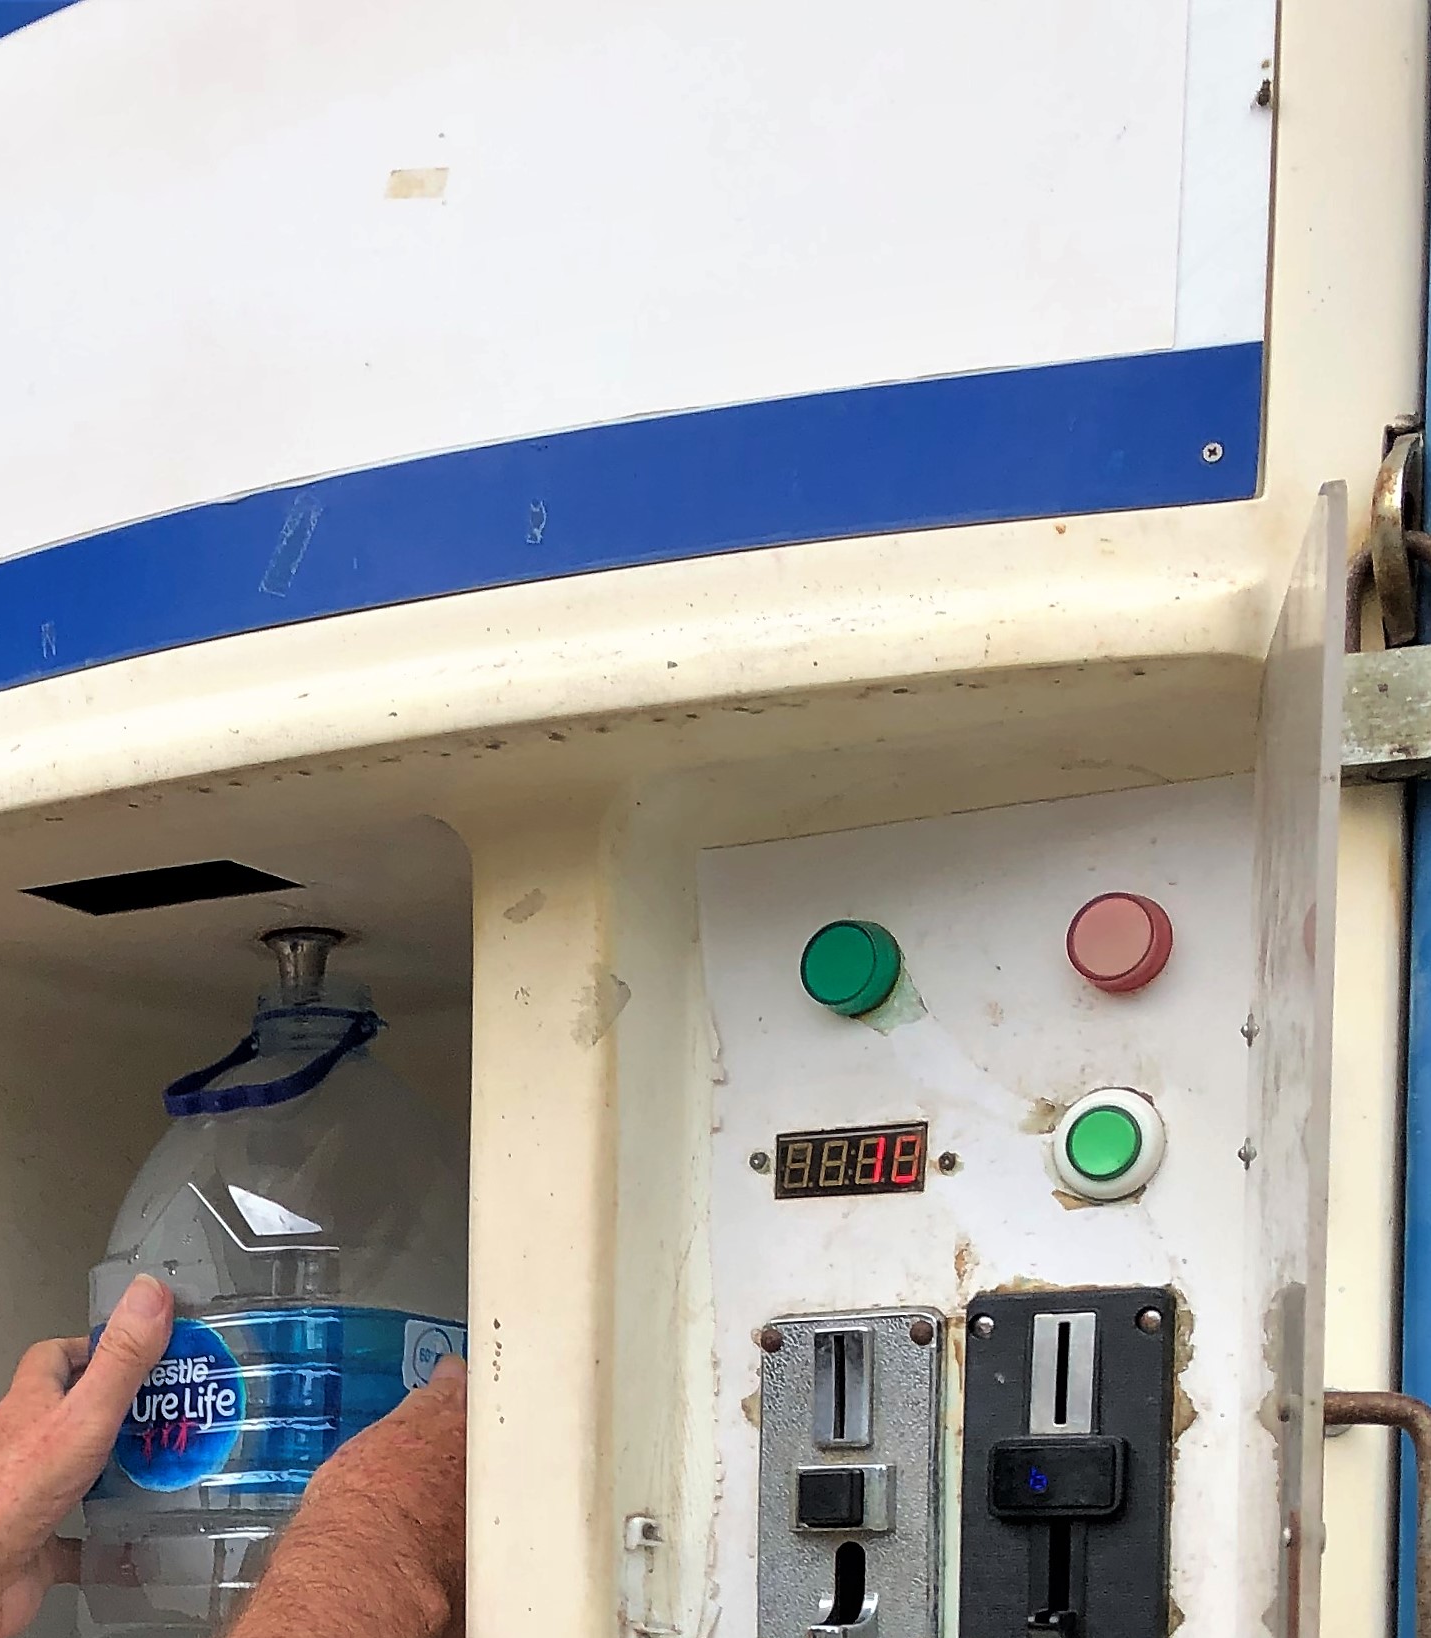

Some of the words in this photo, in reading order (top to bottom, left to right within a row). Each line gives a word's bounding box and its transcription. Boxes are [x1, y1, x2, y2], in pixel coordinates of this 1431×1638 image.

[143, 1356, 208, 1388] estlé
[132, 1392, 179, 1423] ure
[184, 1382, 236, 1431] Life
